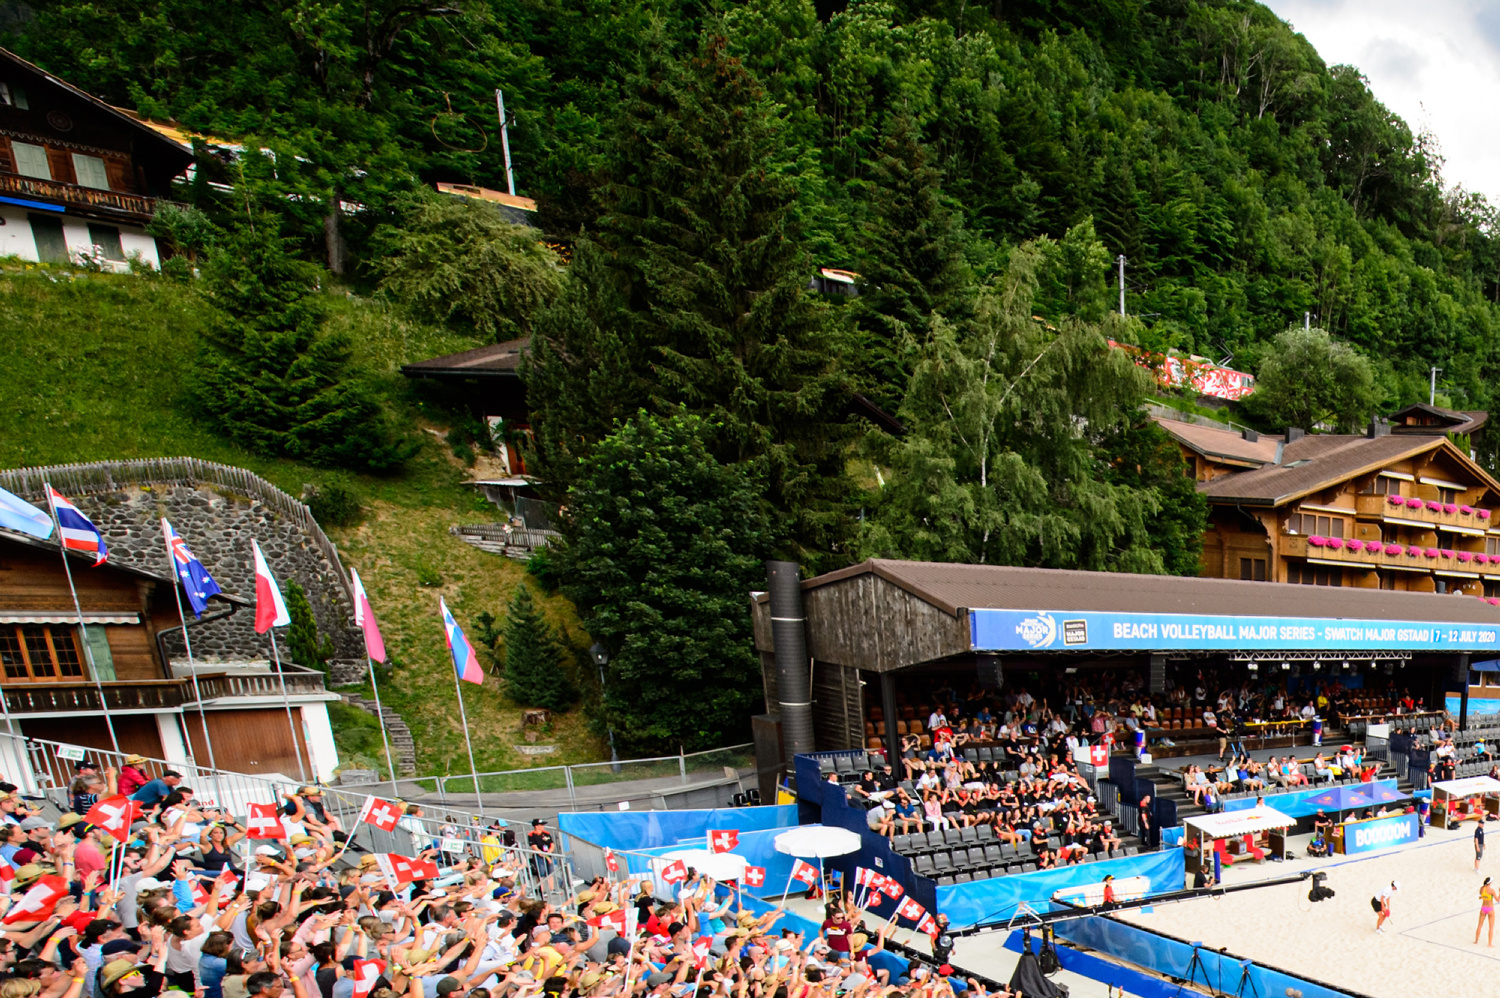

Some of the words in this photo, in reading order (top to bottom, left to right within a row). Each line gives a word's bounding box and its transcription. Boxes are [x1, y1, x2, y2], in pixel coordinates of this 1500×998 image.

[1113, 622, 1158, 639] BEACH
[1160, 623, 1237, 640] VOLLEYBALL
[1239, 625, 1278, 640] MAJOR
[1279, 626, 1315, 641] SERIES
[1324, 628, 1363, 641] SWATCH
[1365, 628, 1395, 642] MAJOR
[1397, 628, 1429, 642] GSTAAD
[1435, 629, 1441, 642] 7
[1448, 630, 1458, 642] 12
[1458, 630, 1477, 643] JULY
[1478, 631, 1496, 643] 2020
[1355, 820, 1411, 847] BOOOOOM
